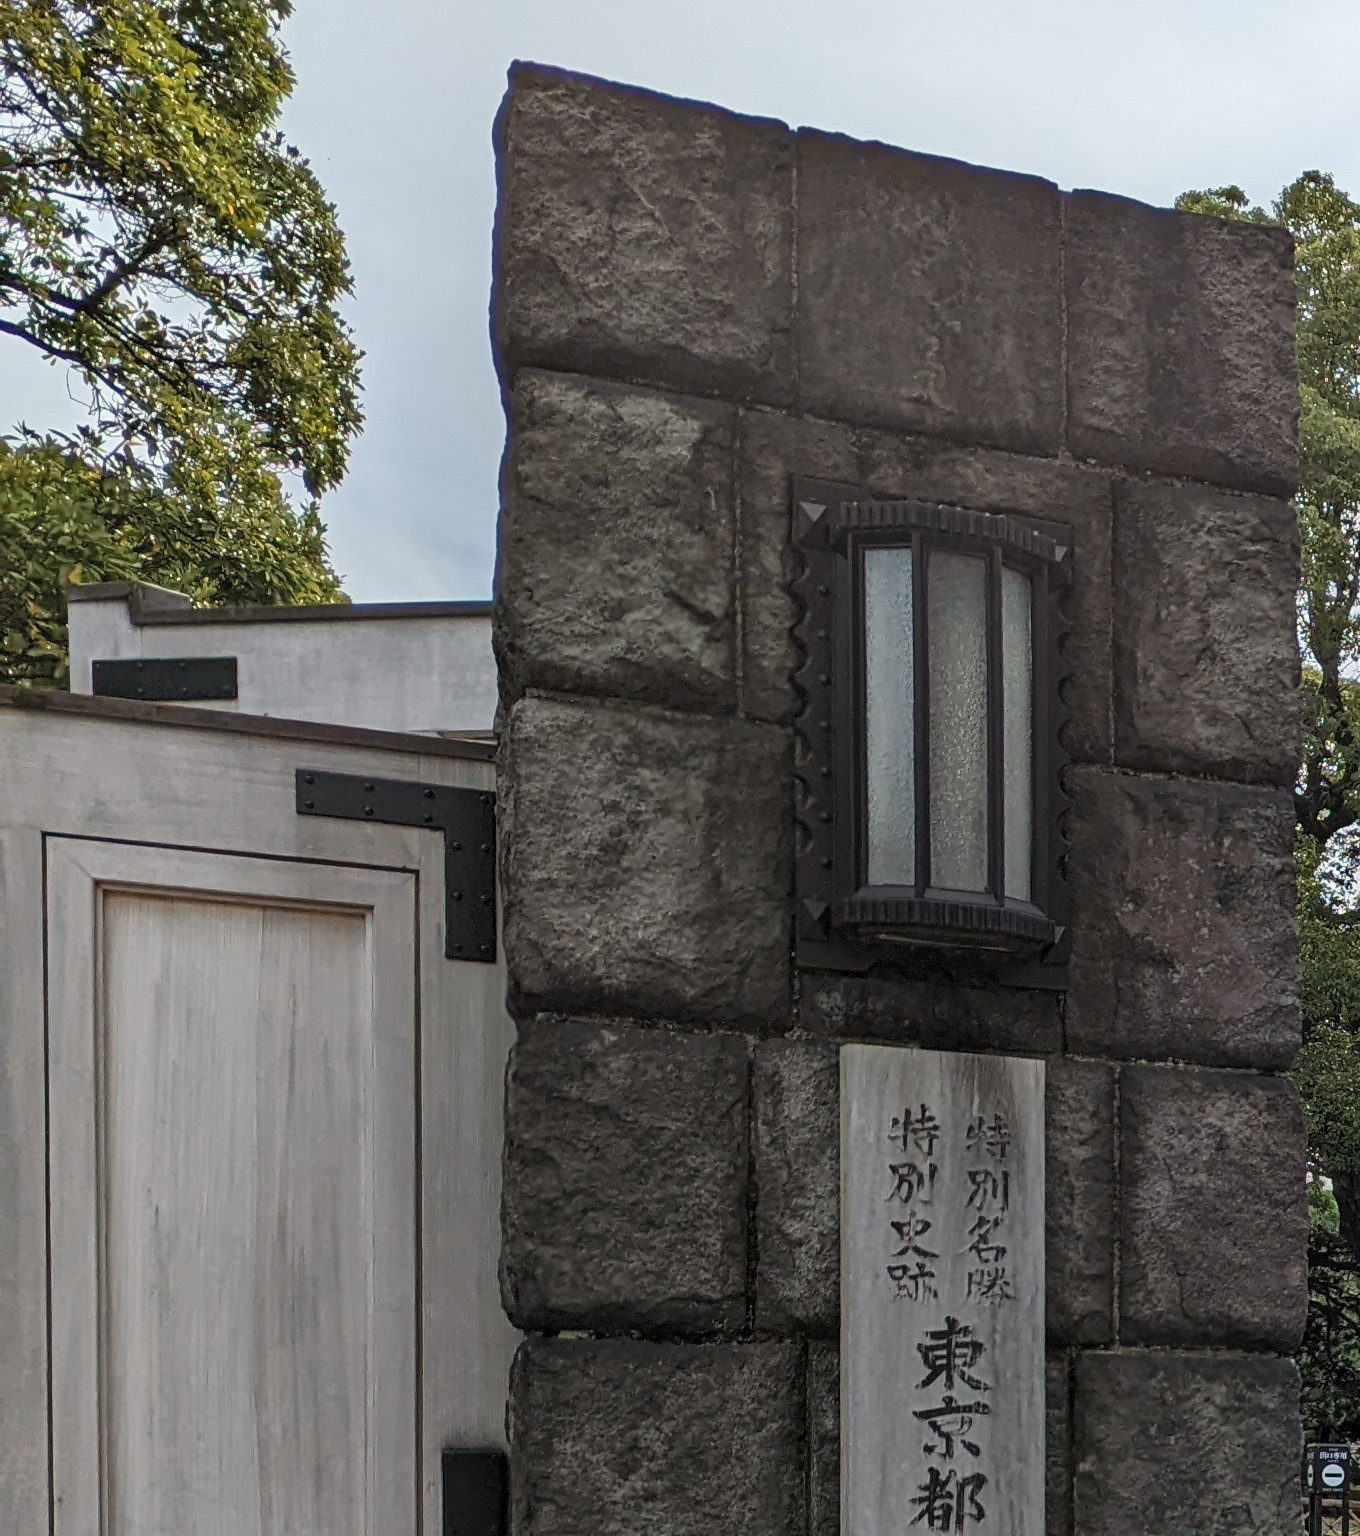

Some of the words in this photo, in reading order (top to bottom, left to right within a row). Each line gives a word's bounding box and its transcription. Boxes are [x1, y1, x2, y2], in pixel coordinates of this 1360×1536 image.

[885, 1102, 940, 1302] 特別史跡
[959, 1112, 1017, 1308] 特別名勝
